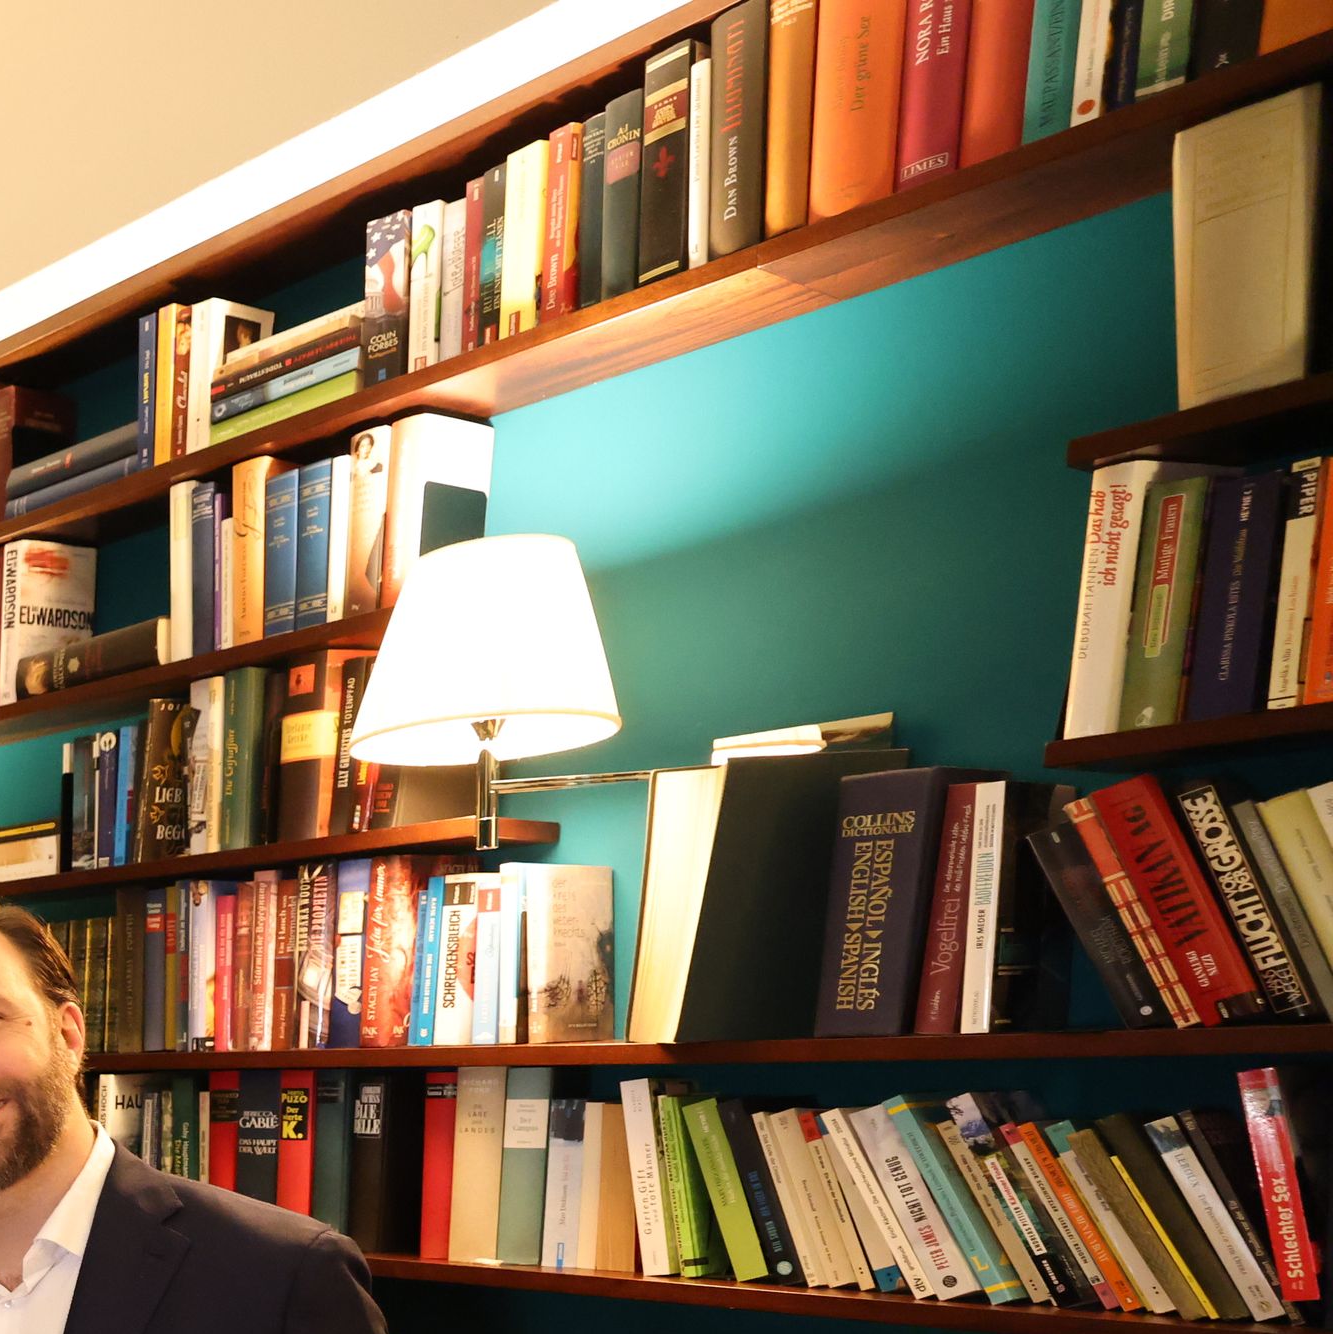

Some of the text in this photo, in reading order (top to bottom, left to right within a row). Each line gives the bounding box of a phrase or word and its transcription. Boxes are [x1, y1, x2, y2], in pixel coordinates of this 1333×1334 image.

[915, 14, 933, 66] NORA
[936, 5, 952, 55] Ein Haus
[608, 128, 641, 150] CRONIN
[904, 155, 946, 179] LIMES
[724, 188, 737, 221] DAN
[546, 253, 559, 310] Dee Brown
[368, 337, 398, 353] FORBES
[370, 330, 396, 344] COLIN
[1299, 473, 1317, 516] PIPER
[1097, 484, 1133, 586] ich nicht gesagt!
[1156, 503, 1178, 580] Mutige Frauen
[1078, 490, 1106, 659] DEBORAH TANNEN Das hab
[842, 810, 916, 829] COLLINS
[842, 823, 915, 838] DICTIONARY
[374, 863, 386, 902] immer
[1123, 804, 1209, 948] VATIKAN AG
[836, 841, 873, 1010] ENGLISH SPANISH
[856, 838, 894, 1011] ESPAÑOL INGLÉS
[930, 898, 961, 976] Vogelfrei
[977, 909, 986, 934] MEDER
[1233, 894, 1288, 971] FLUCHT
[442, 909, 461, 1009] SCHRECKENSBLEICH
[976, 935, 984, 950] IRIS
[368, 966, 379, 982] JAY
[1203, 952, 1220, 978] NUZZI
[367, 985, 378, 1020] STACEY
[239, 1114, 279, 1130] GABLÉ
[282, 1121, 304, 1139] K.
[885, 1155, 950, 1271] PETER JAMES NICHT TOT GENUG
[1271, 1177, 1305, 1279] Schlechter Sex
[913, 1277, 926, 1293] dtv
